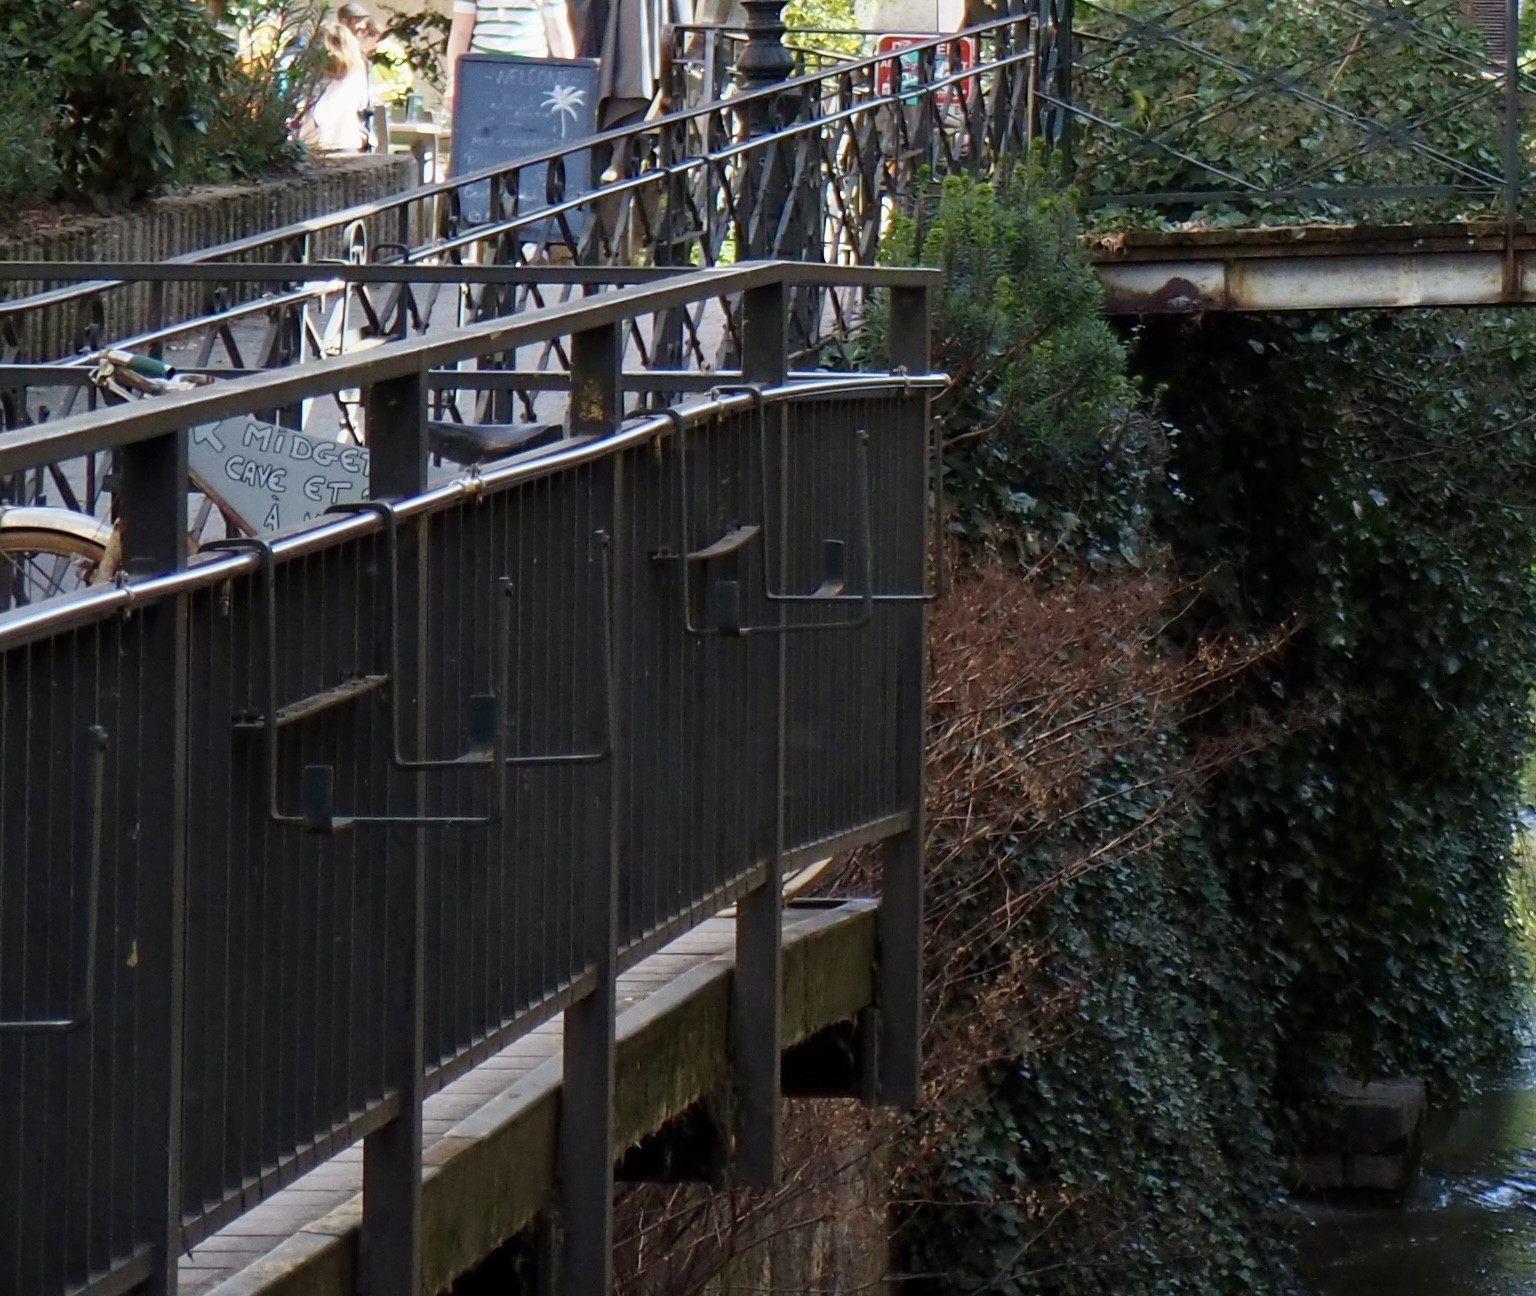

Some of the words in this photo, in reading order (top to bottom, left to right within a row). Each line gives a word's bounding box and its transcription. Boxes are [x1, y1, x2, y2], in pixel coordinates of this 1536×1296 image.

[496, 69, 572, 86] WELCOME
[225, 455, 288, 493] CAVE
[303, 475, 353, 504] ET
